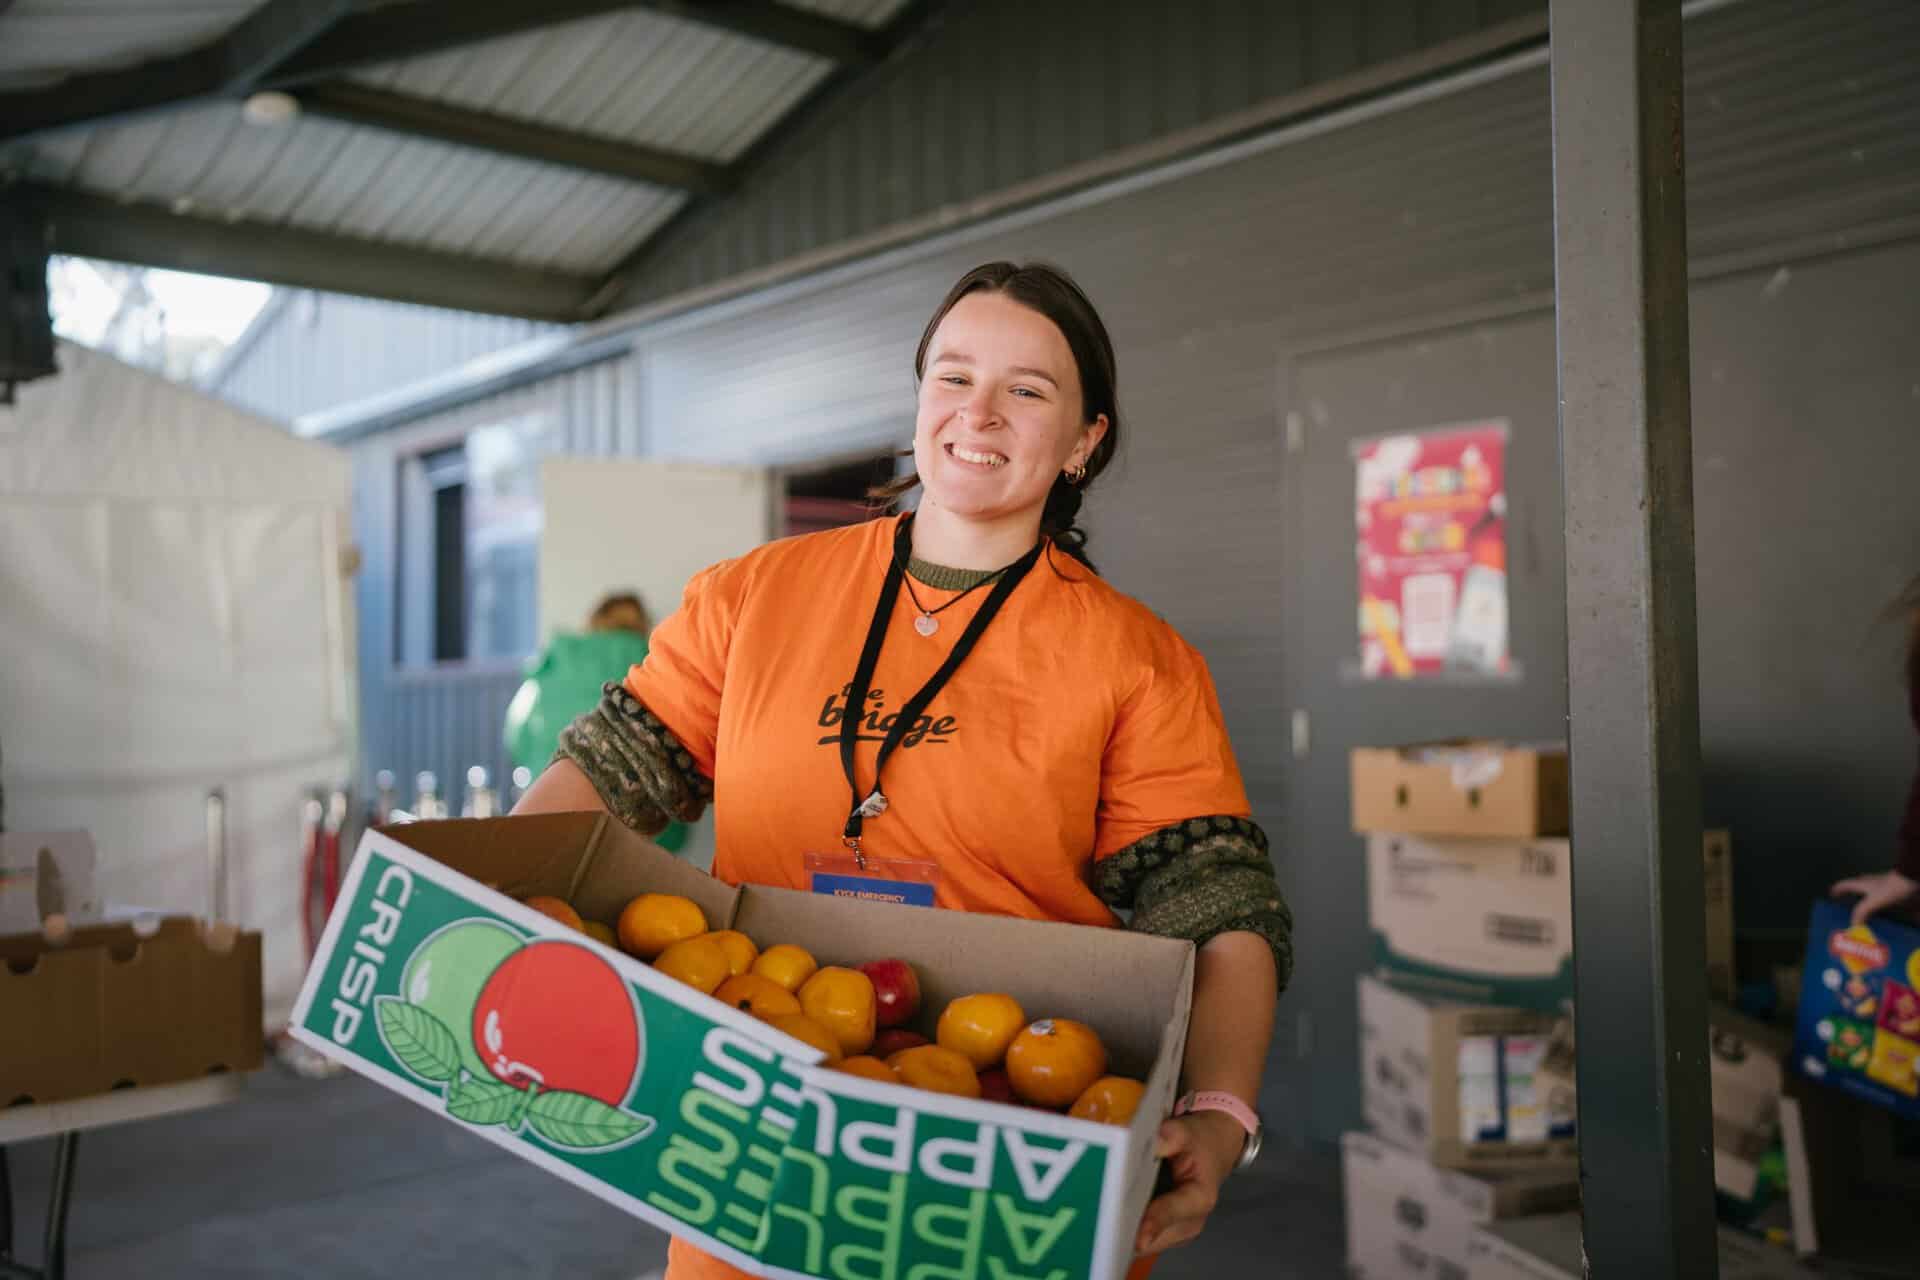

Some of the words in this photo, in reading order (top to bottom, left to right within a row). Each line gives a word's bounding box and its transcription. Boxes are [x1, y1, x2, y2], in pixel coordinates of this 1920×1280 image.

[330, 864, 414, 1046] CRISP
[669, 1087, 1078, 1265] APPLES
[692, 1024, 1089, 1203] APPLES
